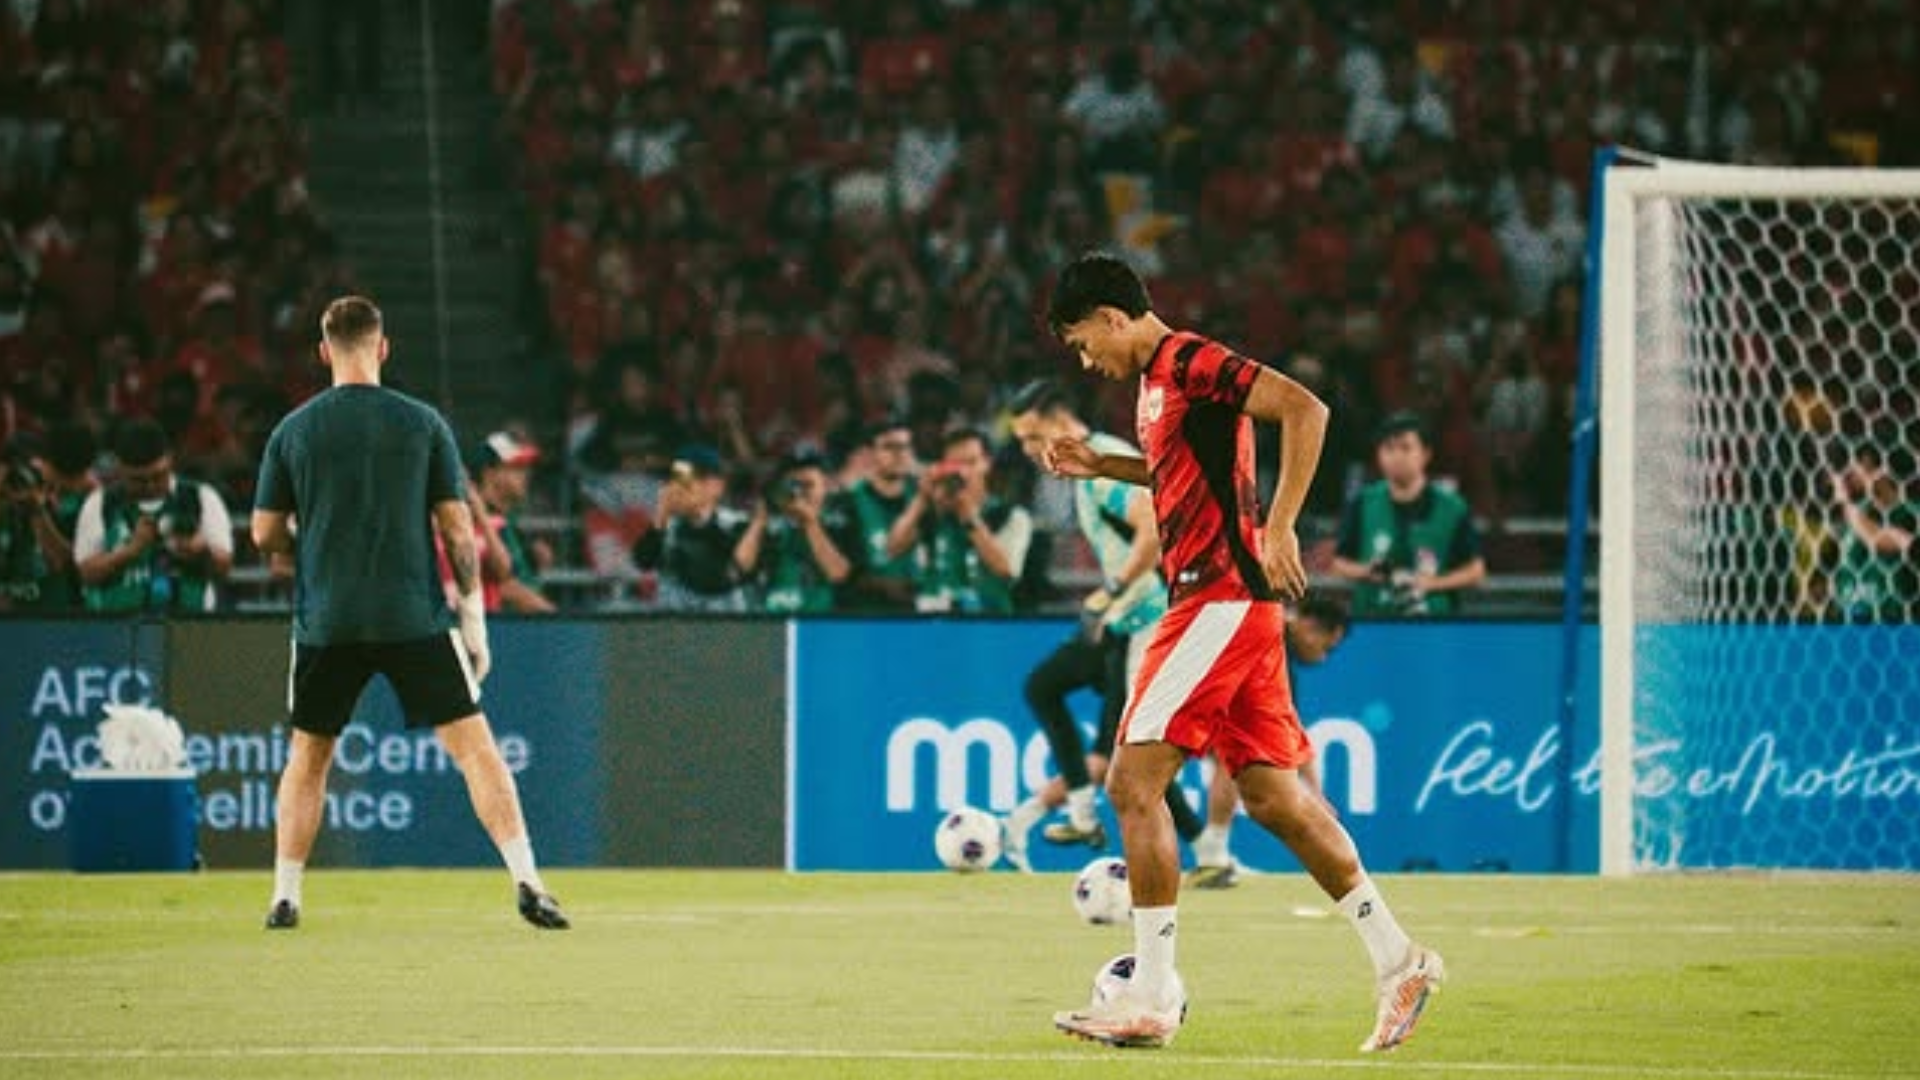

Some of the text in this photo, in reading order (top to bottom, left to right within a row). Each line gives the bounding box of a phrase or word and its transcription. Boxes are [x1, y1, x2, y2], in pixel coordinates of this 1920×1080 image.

[32, 666, 151, 717] AFC
[31, 723, 528, 773] Acemi Cene
[30, 790, 72, 830] o
